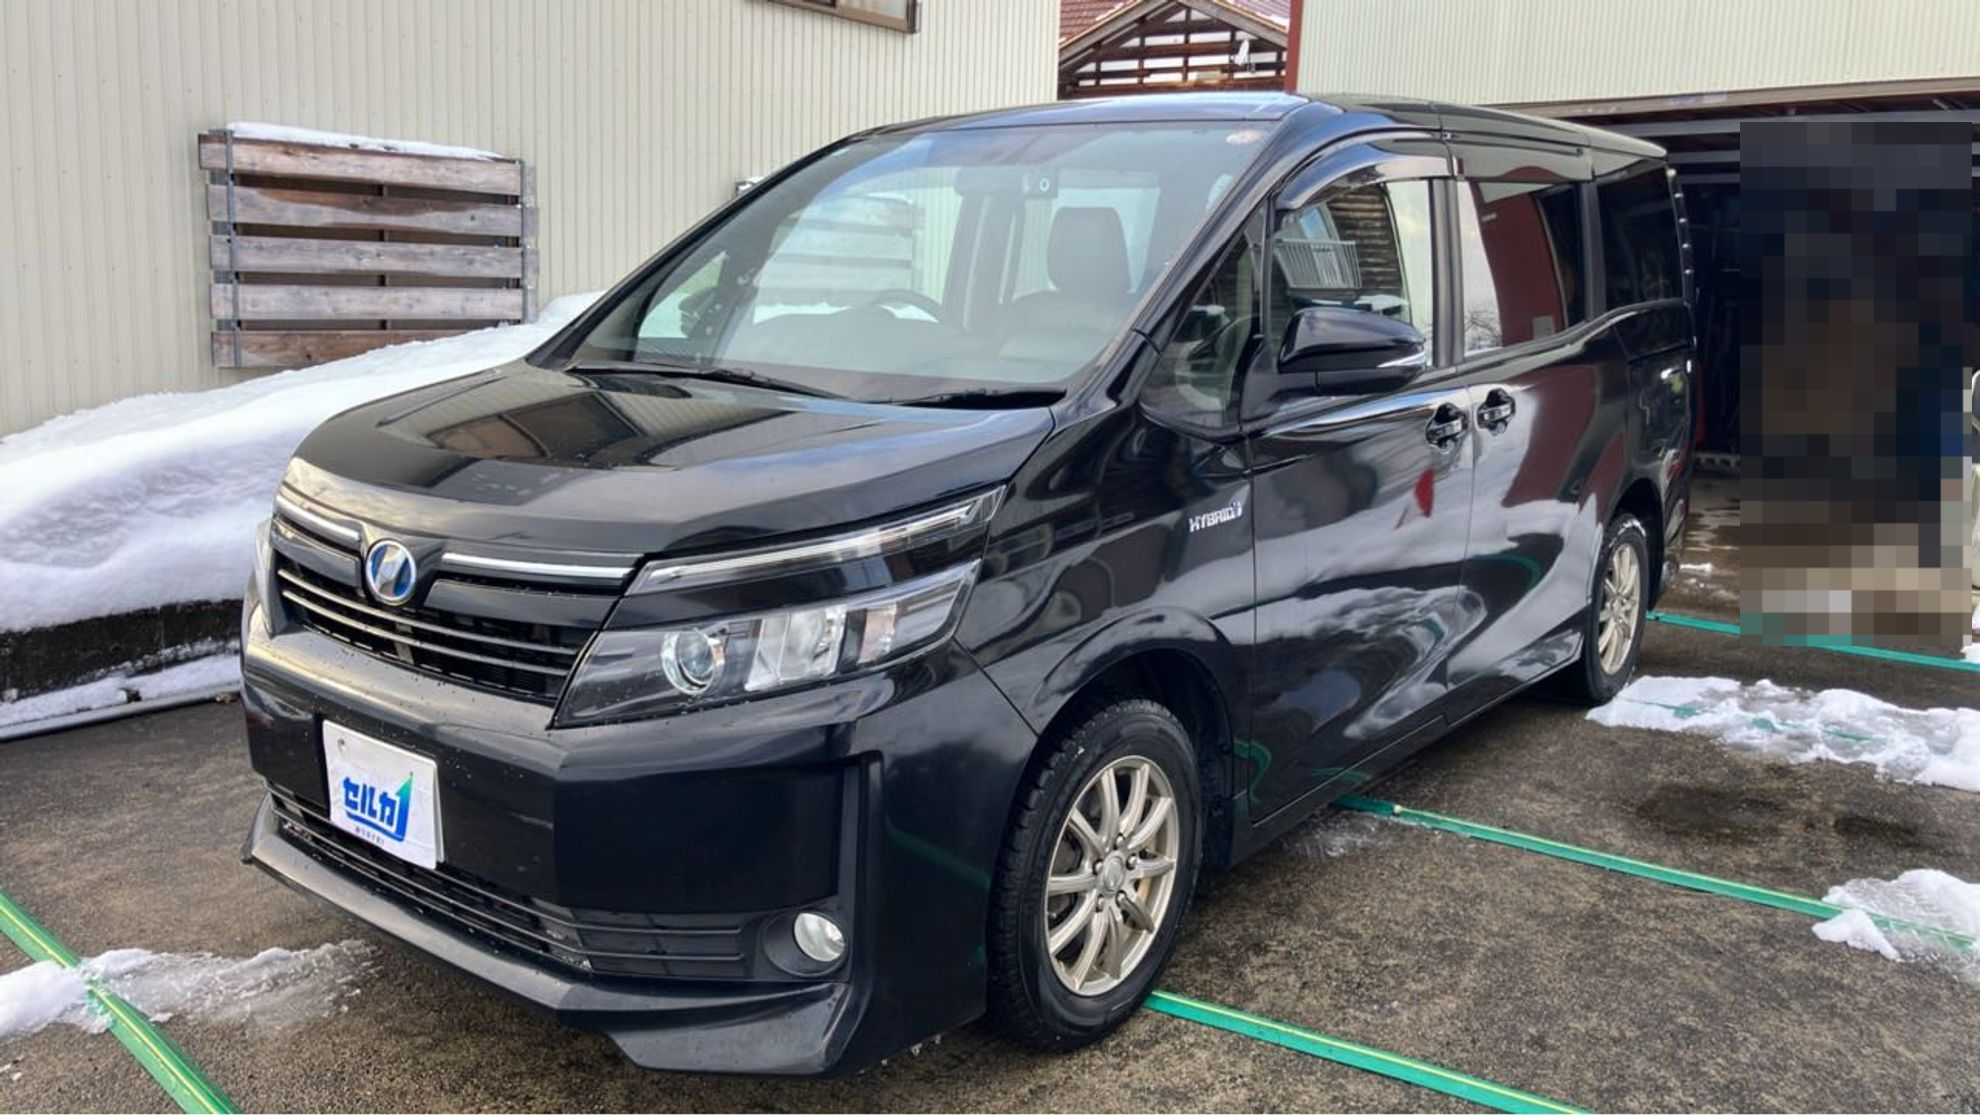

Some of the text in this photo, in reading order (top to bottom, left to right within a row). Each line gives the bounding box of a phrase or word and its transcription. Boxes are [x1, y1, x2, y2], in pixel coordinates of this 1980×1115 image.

[1189, 507, 1235, 532] HYBRID
[343, 777, 397, 827] セルカ
